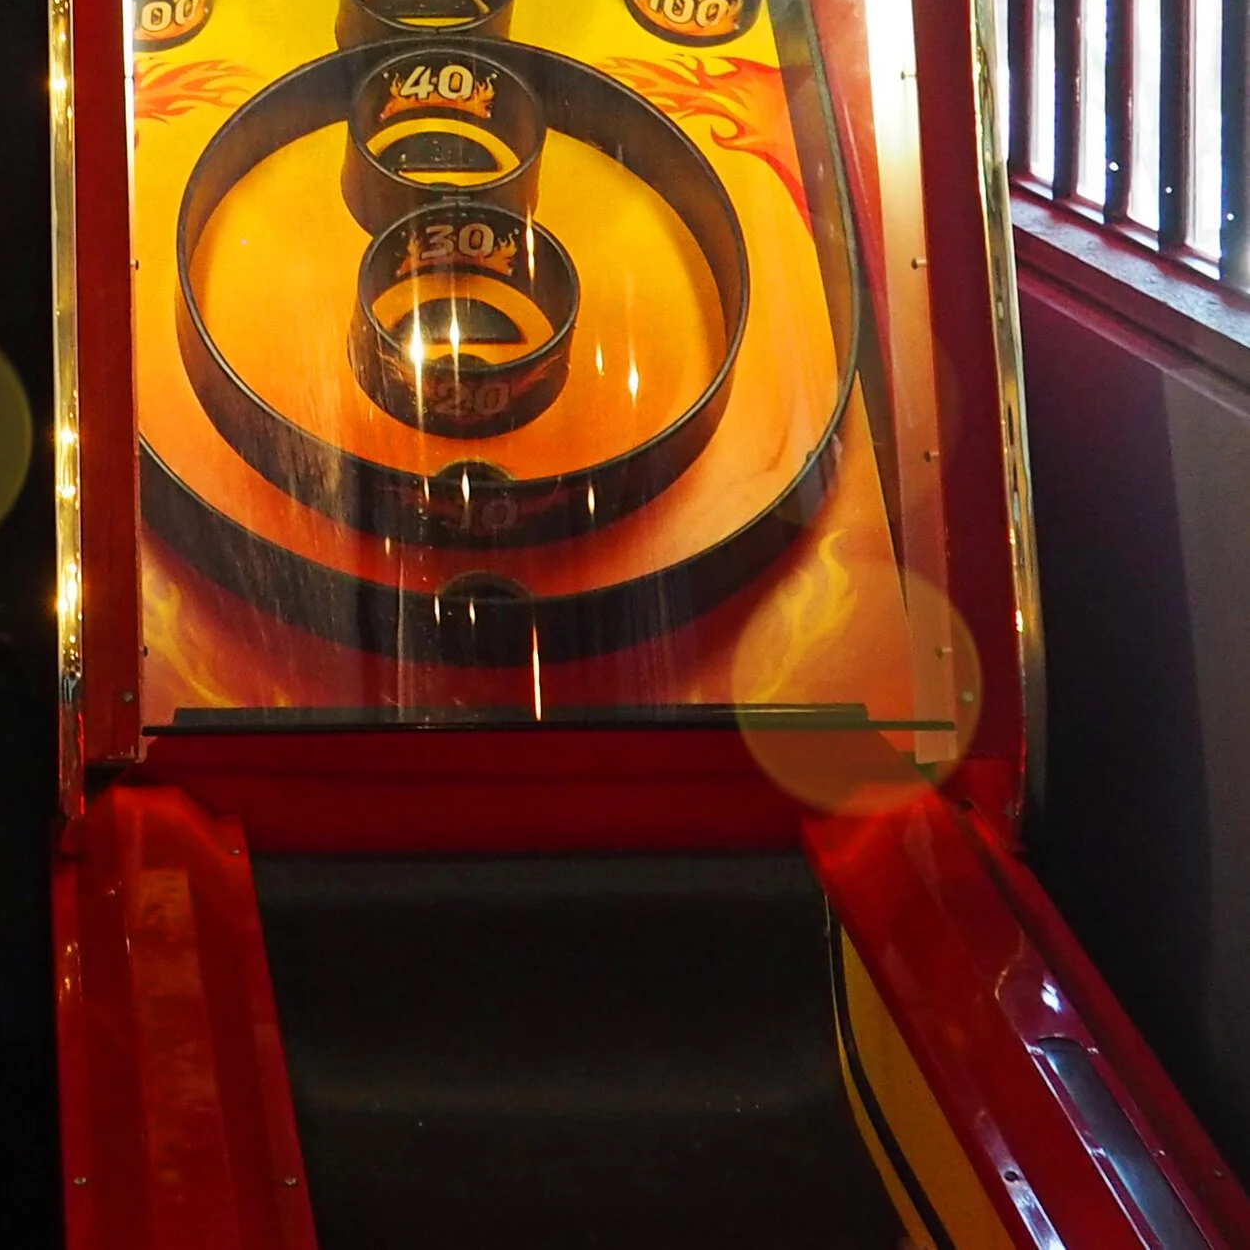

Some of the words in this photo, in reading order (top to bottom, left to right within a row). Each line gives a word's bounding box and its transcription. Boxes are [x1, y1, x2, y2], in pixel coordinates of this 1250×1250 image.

[398, 63, 475, 101] 40
[421, 222, 495, 260] 30
[432, 380, 512, 417] 20
